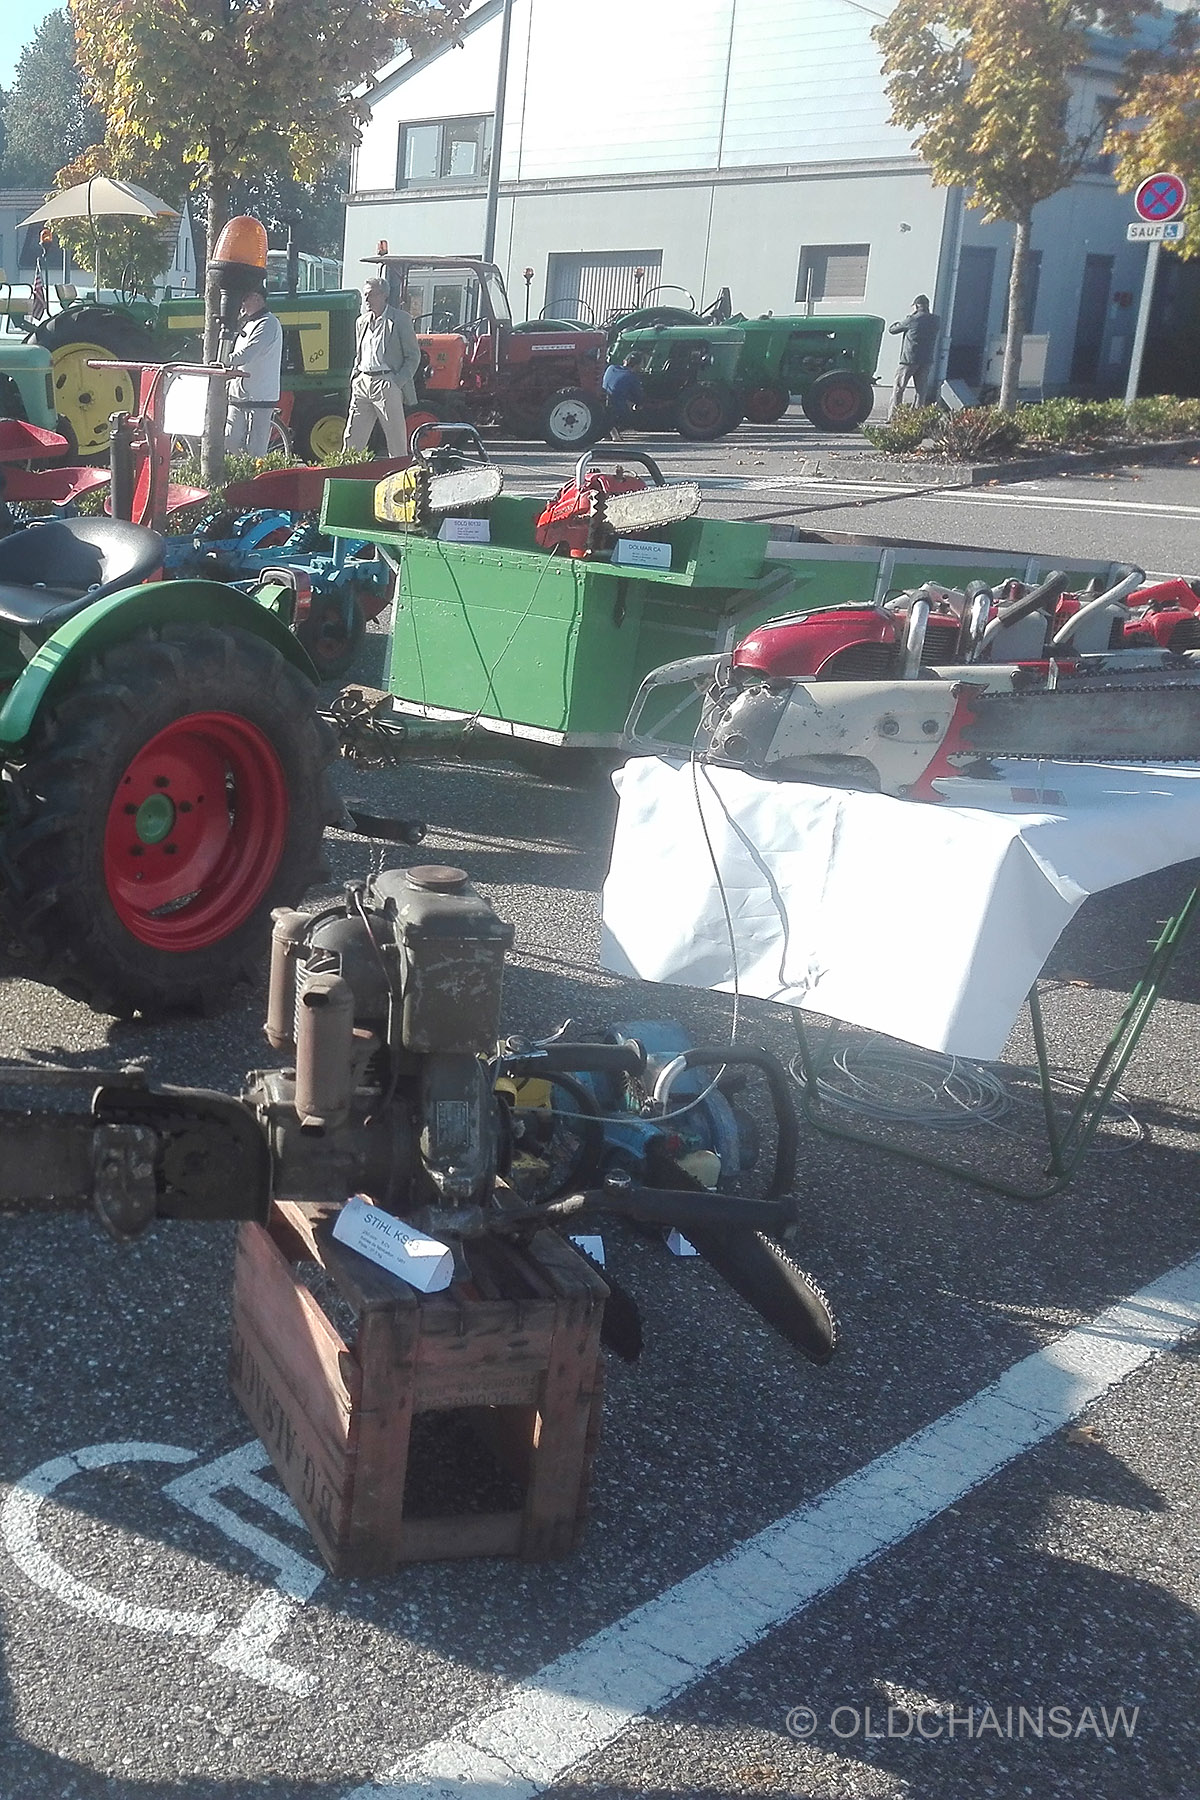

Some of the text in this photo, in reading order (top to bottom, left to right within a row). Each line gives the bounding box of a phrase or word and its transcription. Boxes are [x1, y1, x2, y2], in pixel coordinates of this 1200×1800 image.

[1131, 226, 1161, 237] SAUF
[310, 349, 324, 363] 620
[364, 1213, 392, 1236] STIHL
